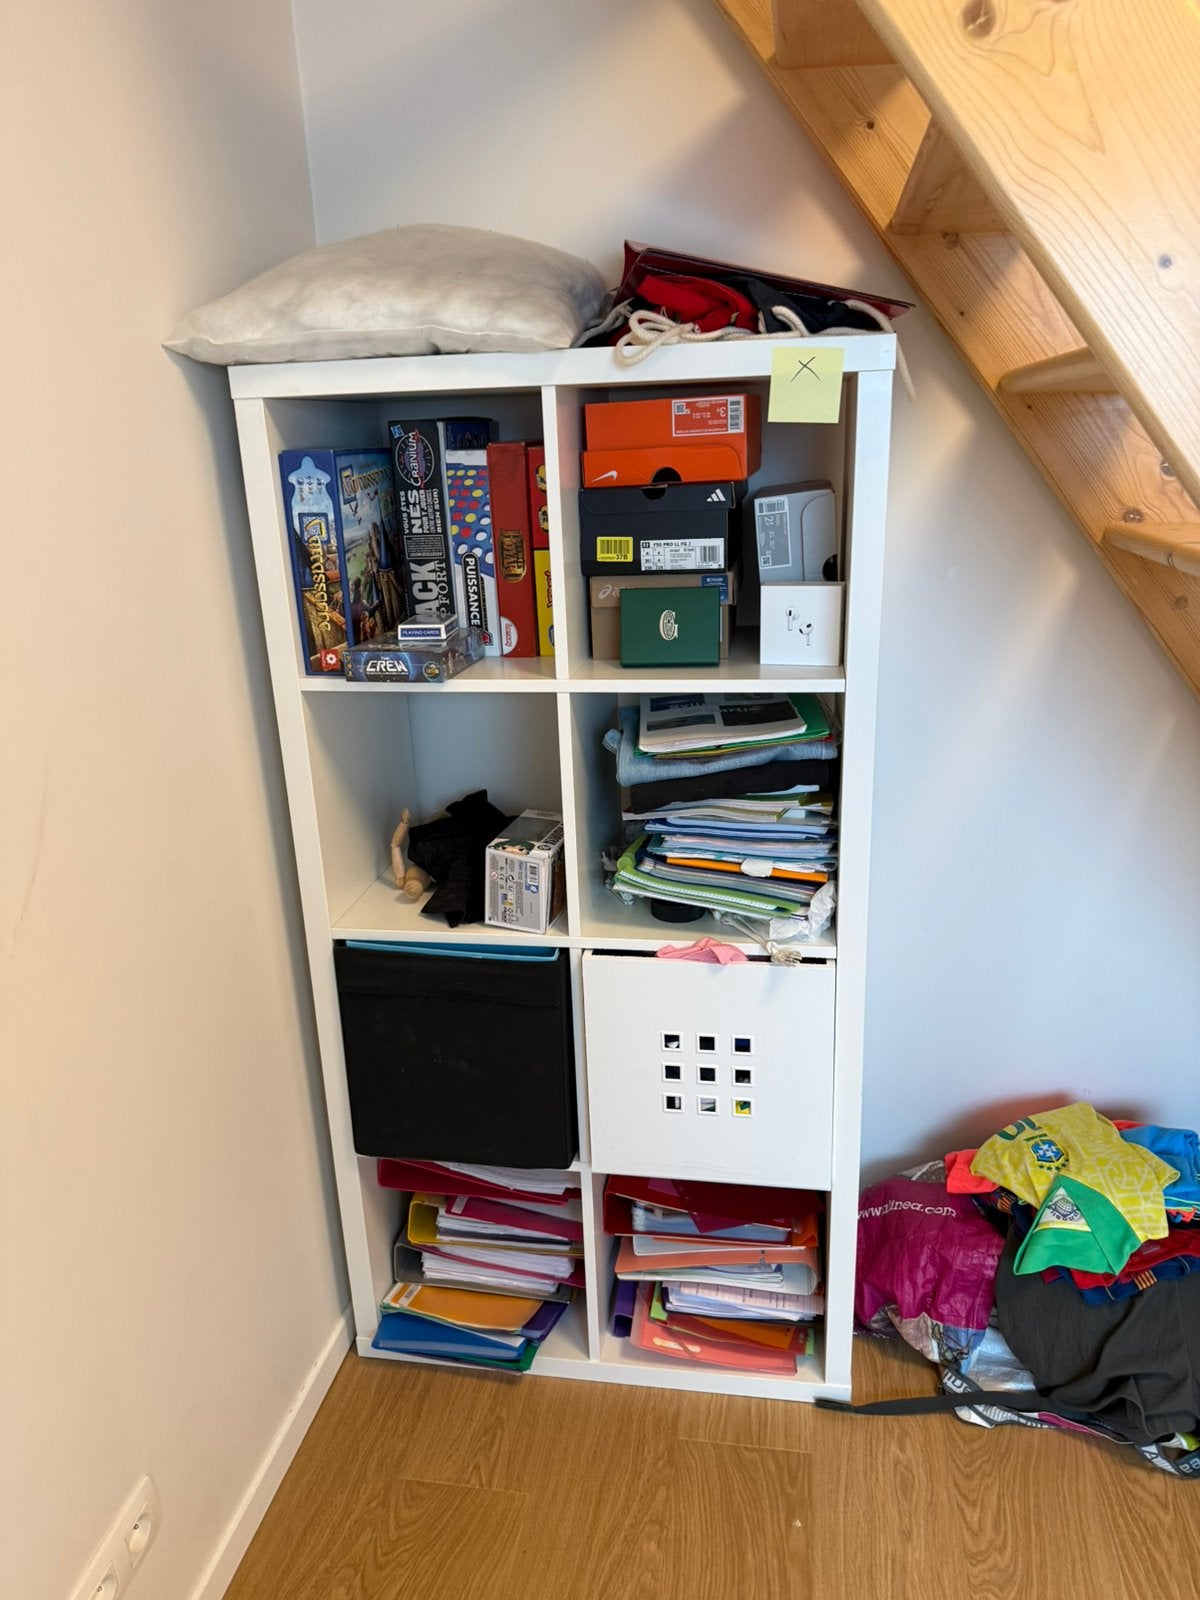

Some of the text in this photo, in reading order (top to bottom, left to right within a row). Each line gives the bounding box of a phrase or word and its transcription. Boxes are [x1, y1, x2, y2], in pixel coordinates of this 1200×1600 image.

[409, 431, 422, 486] CRANIUM
[407, 489, 422, 534] NÉS
[419, 489, 427, 511] JOUER
[422, 516, 430, 534] POUR
[305, 518, 331, 631] Carcassonne
[411, 561, 439, 616] ACK
[465, 557, 480, 626] PUISSANCE
[366, 660, 408, 672] CREW
